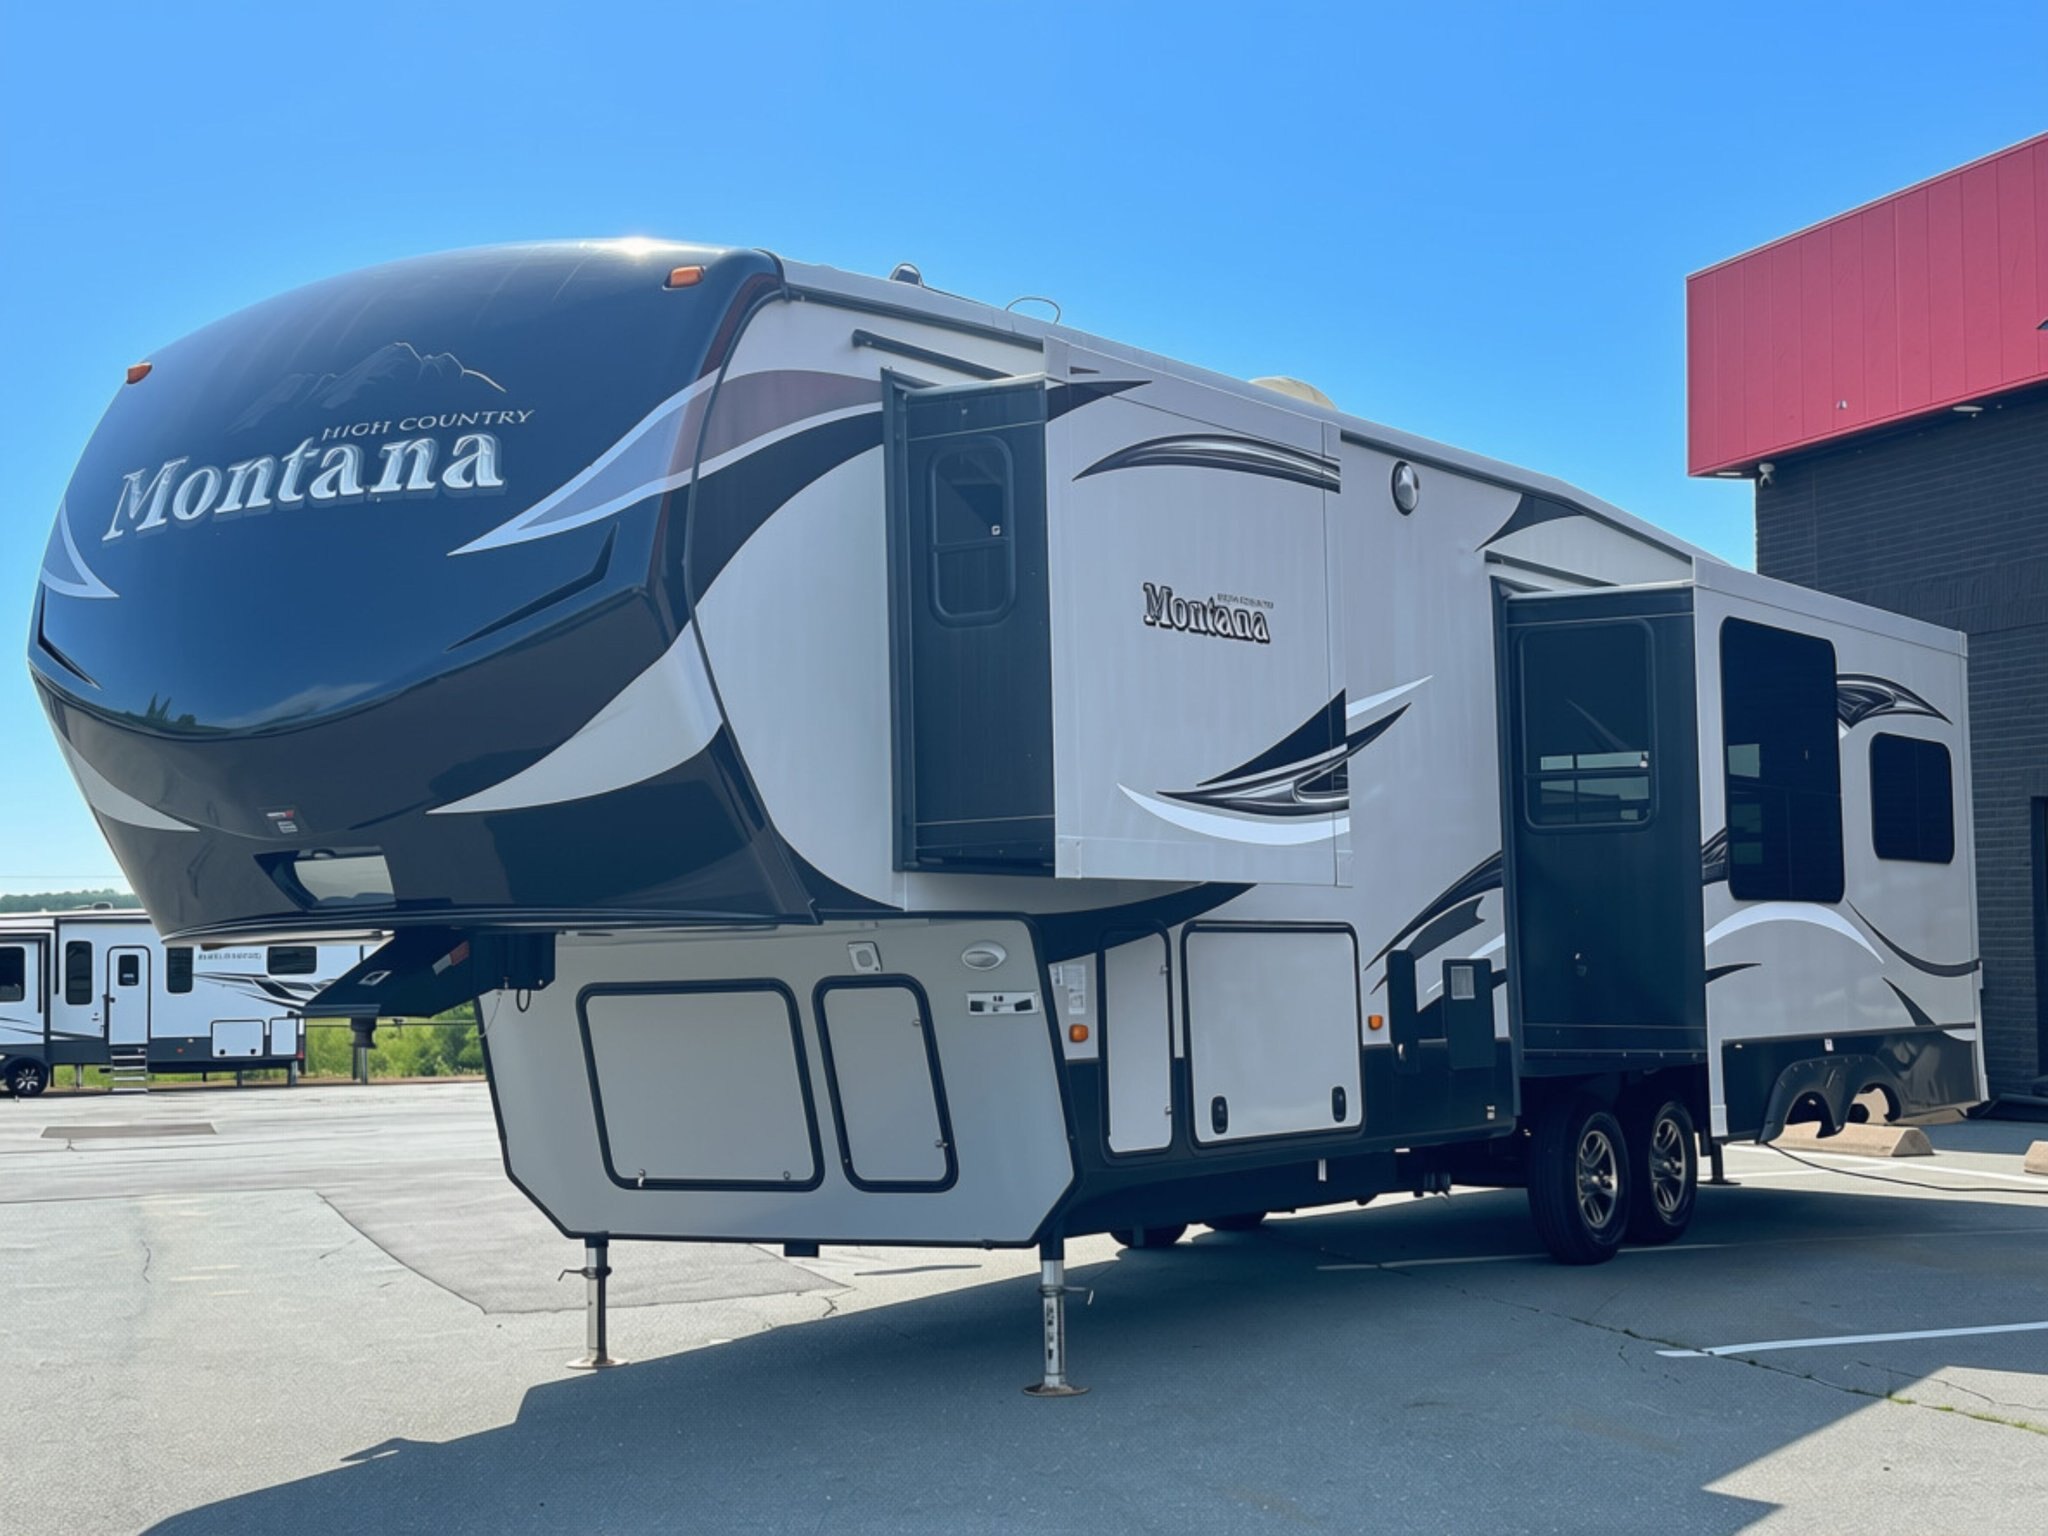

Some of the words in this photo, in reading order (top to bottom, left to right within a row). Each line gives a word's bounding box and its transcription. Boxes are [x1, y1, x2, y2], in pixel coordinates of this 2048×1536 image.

[321, 420, 392, 441] HIGH
[399, 409, 535, 432] COUNTRY
[101, 432, 506, 543] Montana
[1143, 582, 1270, 644] Montana
